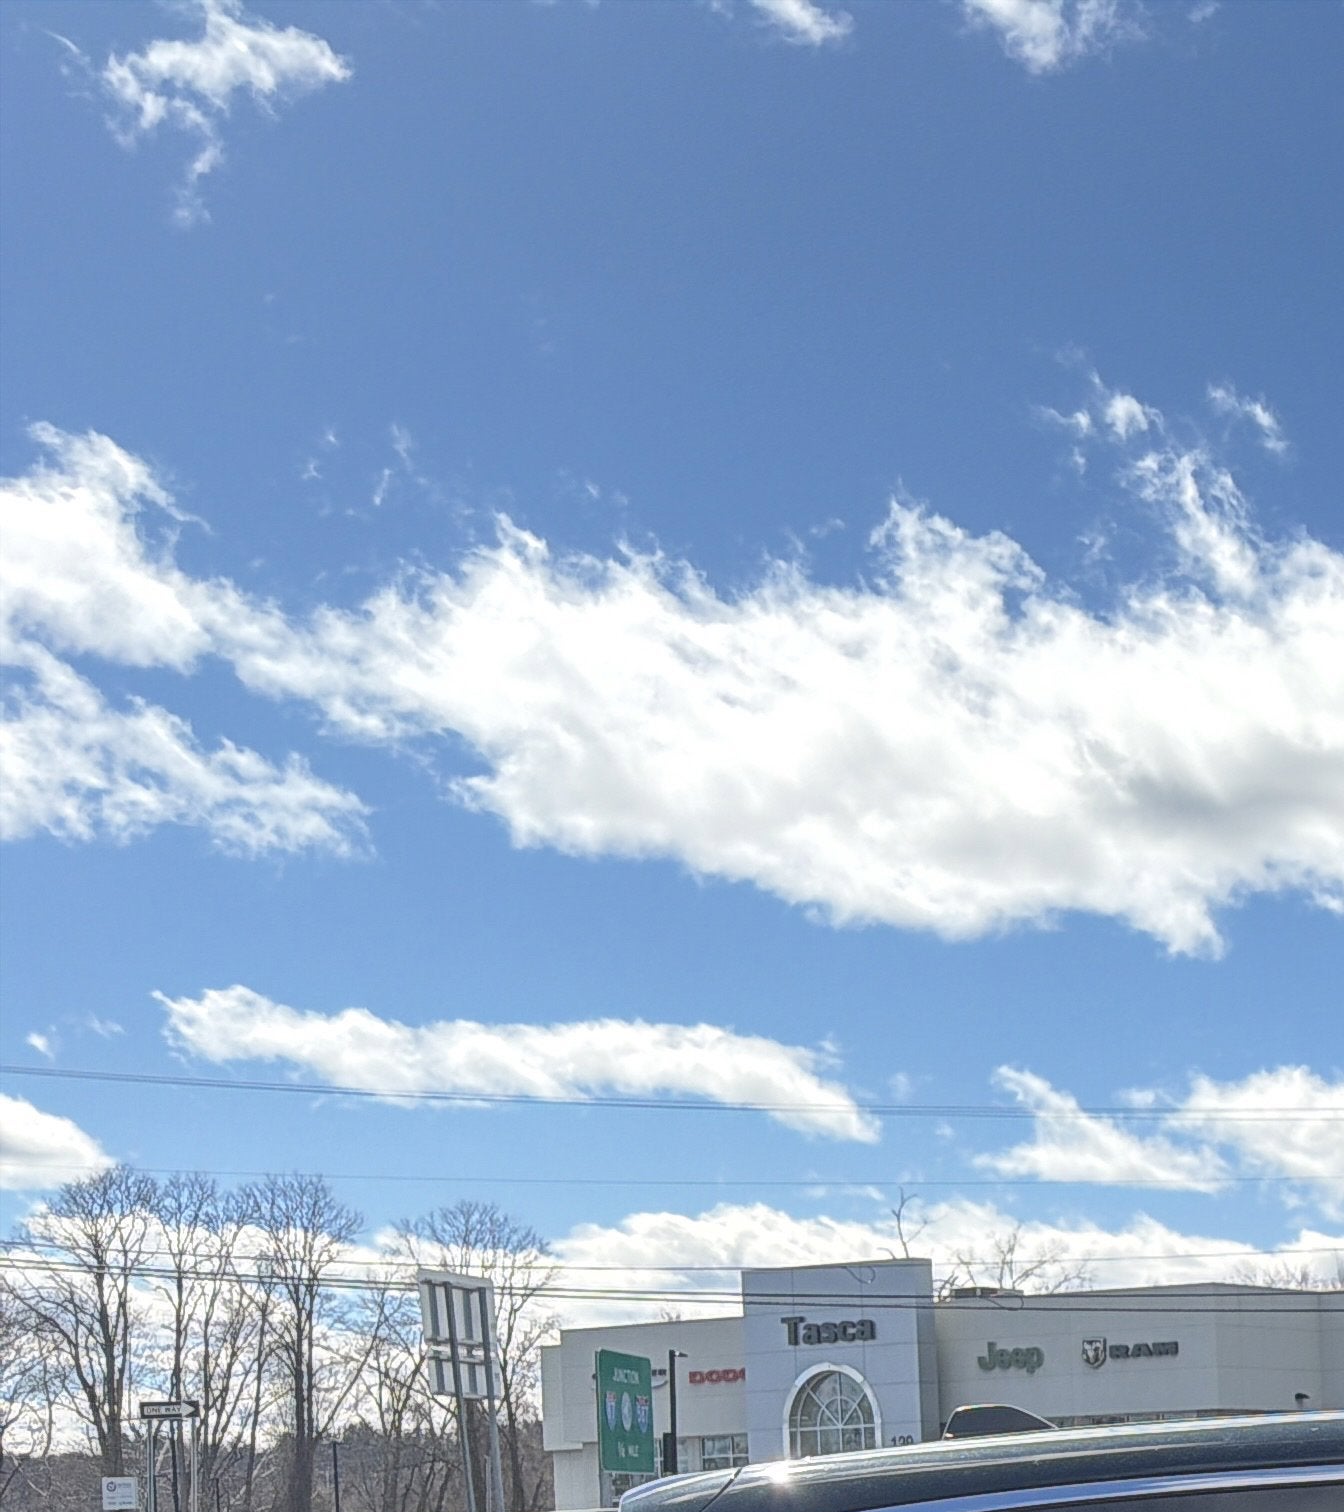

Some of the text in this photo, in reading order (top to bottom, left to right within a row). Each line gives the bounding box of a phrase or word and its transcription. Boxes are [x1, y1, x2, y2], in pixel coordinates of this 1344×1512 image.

[780, 1316, 876, 1346] Tasca
[977, 1341, 1045, 1374] Jeep
[1109, 1341, 1179, 1360] RAM
